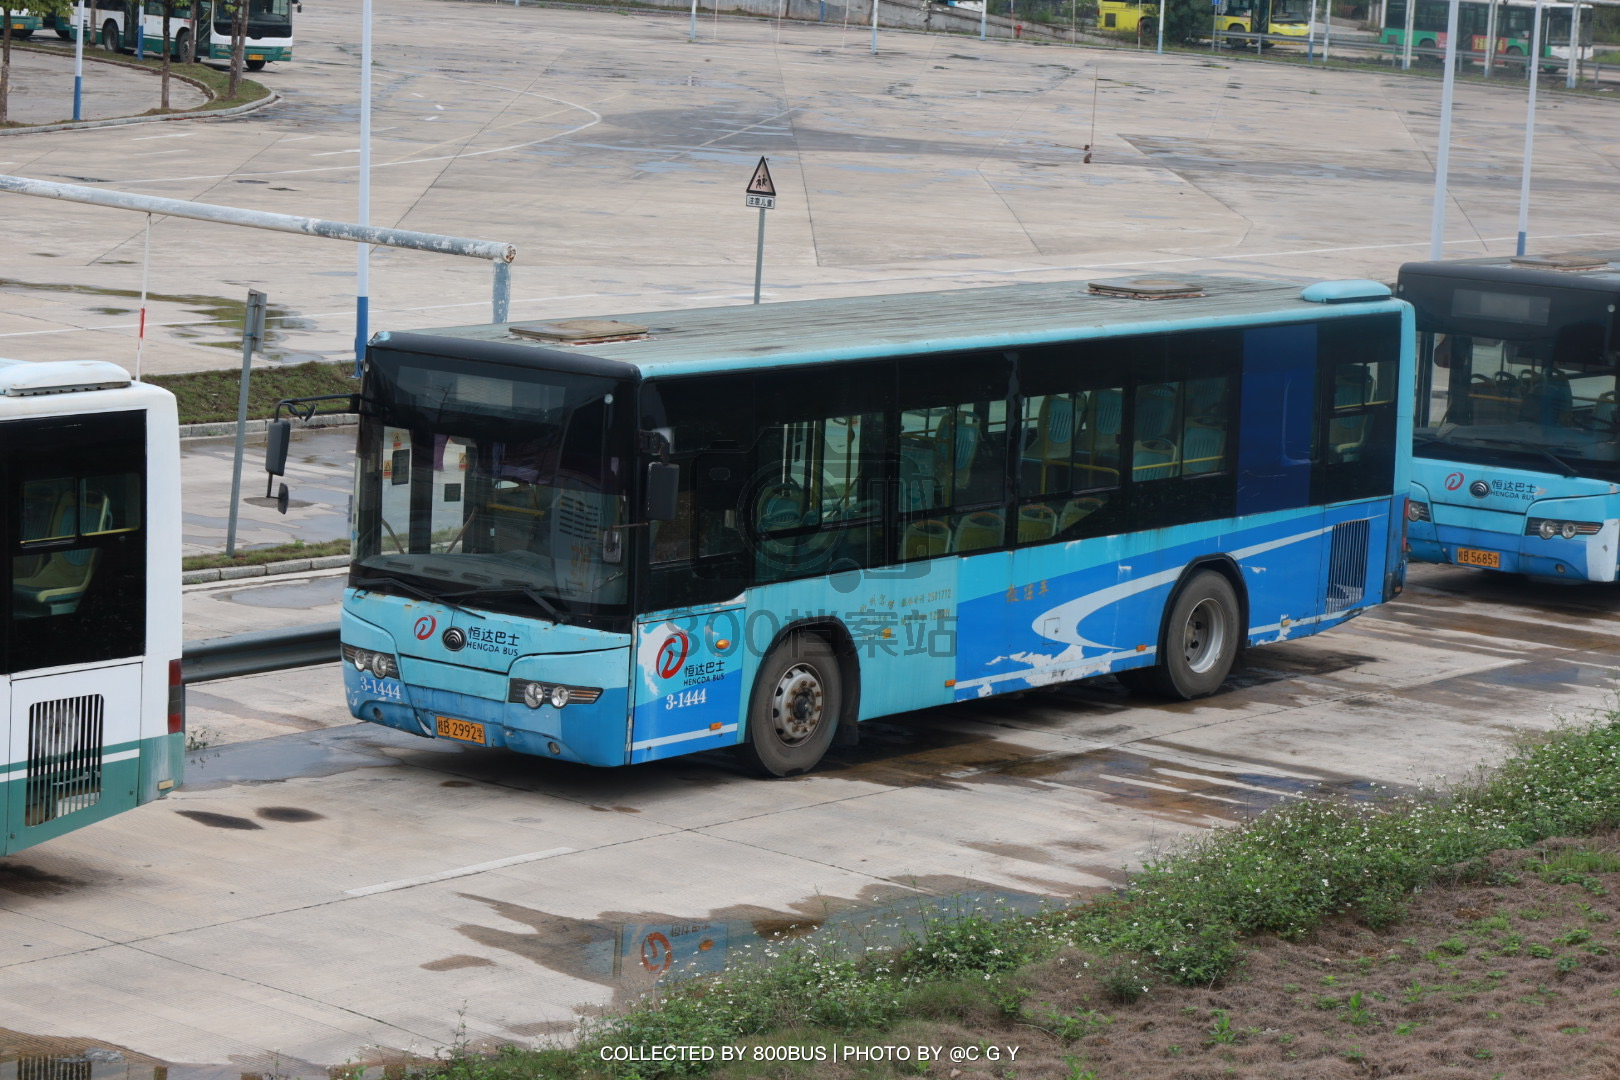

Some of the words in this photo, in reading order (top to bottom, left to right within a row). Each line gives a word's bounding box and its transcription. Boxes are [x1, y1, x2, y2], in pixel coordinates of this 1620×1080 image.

[1491, 479, 1536, 494] 恒达巴士
[1490, 490, 1520, 500] HENGDA
[1522, 493, 1535, 501] BUS
[468, 626, 520, 646] 恒达巴士
[466, 640, 500, 654] HENGDA
[503, 646, 519, 656] BUS
[684, 660, 725, 677] 恒达巴士
[684, 675, 711, 686] HENGDA
[712, 673, 725, 681] BUS
[360, 677, 401, 699] 3-1444
[665, 687, 707, 710] 3-1444
